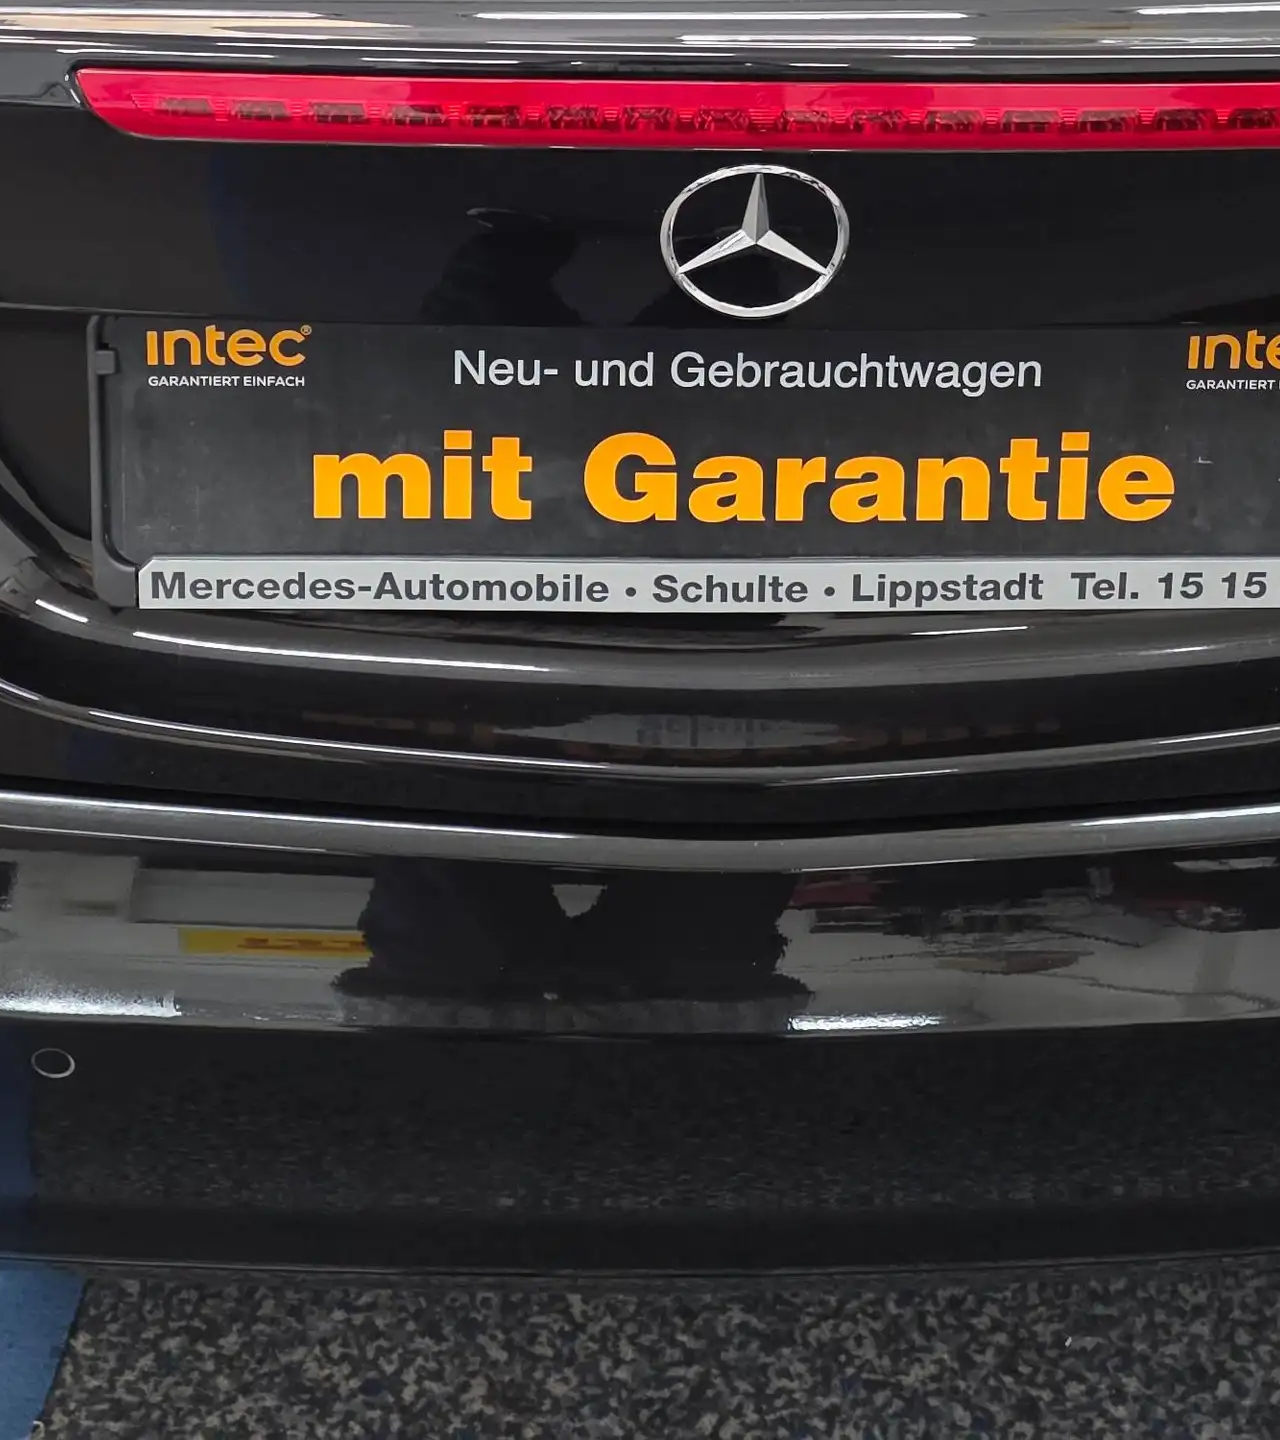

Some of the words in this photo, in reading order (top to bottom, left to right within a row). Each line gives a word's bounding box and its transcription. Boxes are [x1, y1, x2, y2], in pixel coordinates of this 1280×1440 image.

[147, 375, 241, 388] GARANTIERT
[243, 375, 306, 388] EINFACH
[454, 349, 559, 387] Neu-
[575, 351, 654, 388] und
[670, 350, 1043, 399] Gebrauchtwagen
[1185, 379, 1276, 391] GARANTIERT
[312, 429, 534, 521] mit
[583, 431, 1176, 524] Garantie
[150, 571, 610, 603] Mercedes-Automobile
[652, 573, 809, 604] Schulte
[851, 572, 1045, 609] Lippstadt
[1070, 571, 1140, 601] Tel.
[1157, 571, 1205, 601] 15
[1221, 571, 1268, 600] 15
